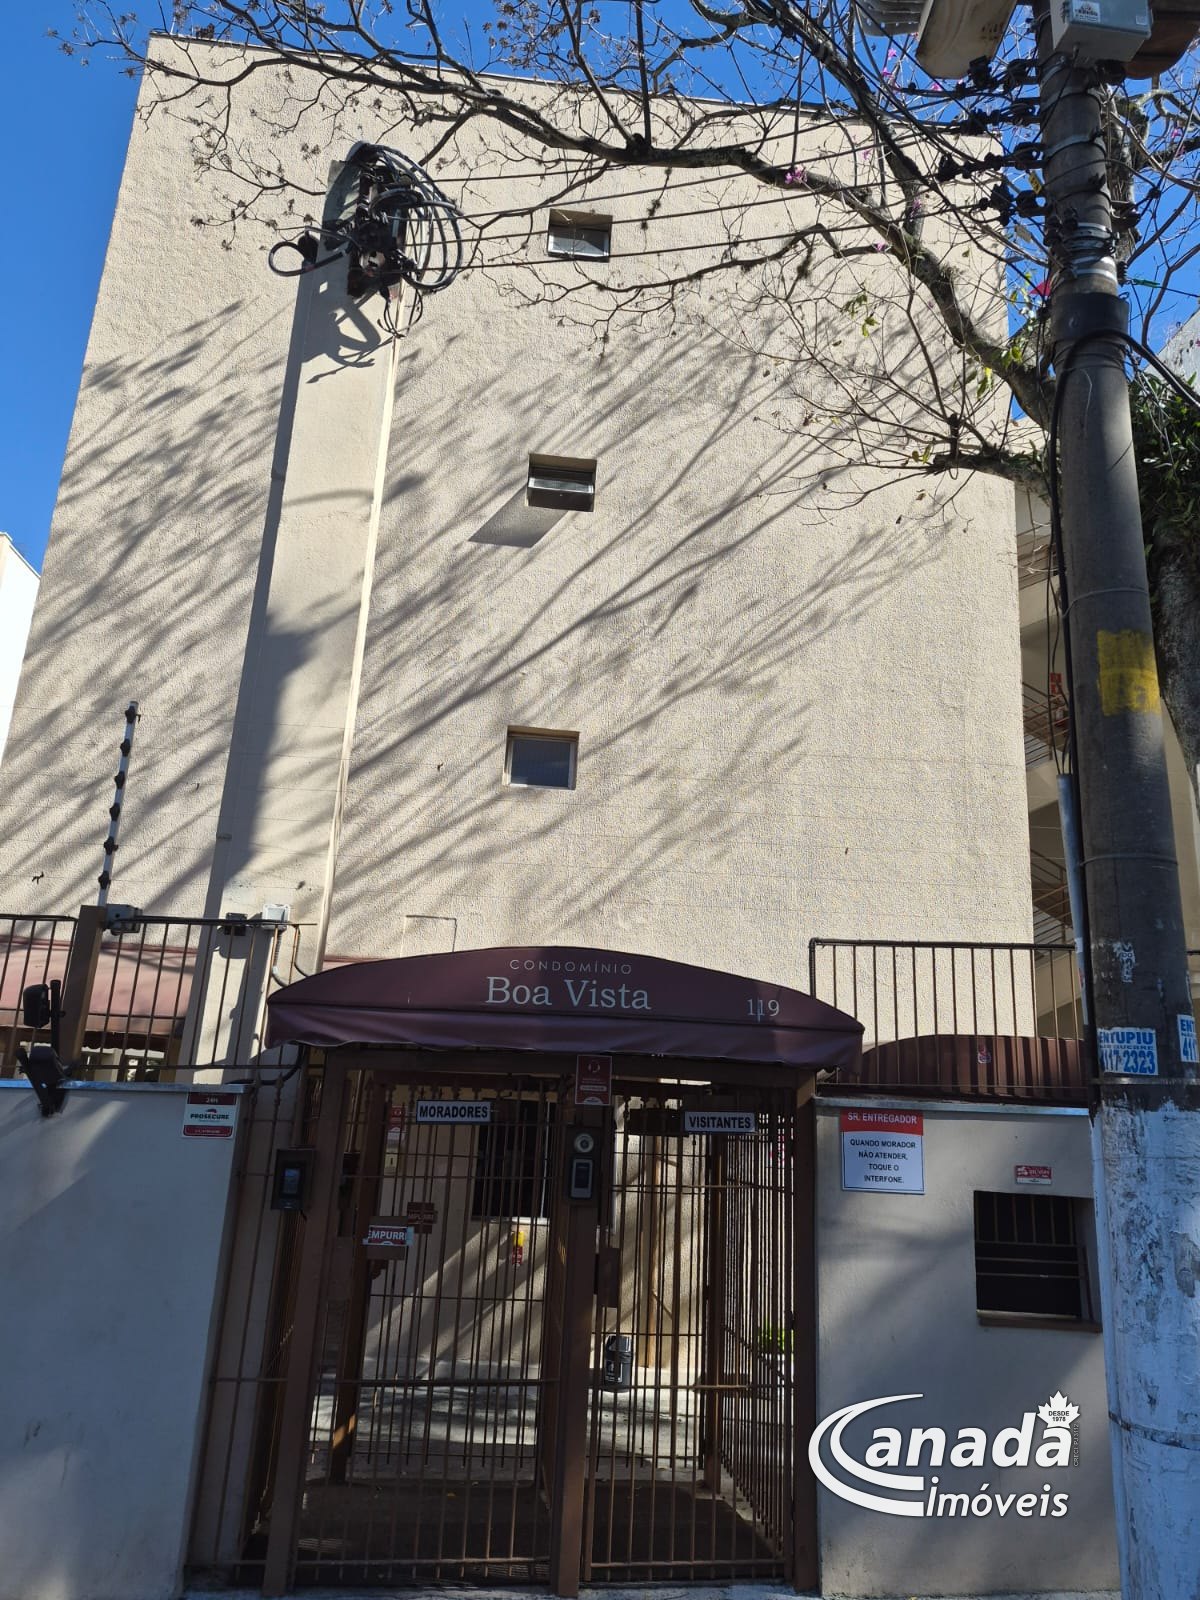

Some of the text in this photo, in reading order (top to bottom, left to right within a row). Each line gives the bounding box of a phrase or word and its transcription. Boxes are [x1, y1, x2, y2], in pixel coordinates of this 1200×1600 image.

[510, 959, 632, 975] CONDOMÍNIO
[485, 976, 652, 1010] Boa Vista
[419, 1105, 489, 1119] MORADORES
[689, 1115, 752, 1129] VISITANTES
[862, 1114, 917, 1124] ENTREGADOR
[850, 1139, 916, 1148] QUANDO MORADOR
[858, 1149, 874, 1158] NÃO
[868, 1163, 892, 1171] TOQUE
